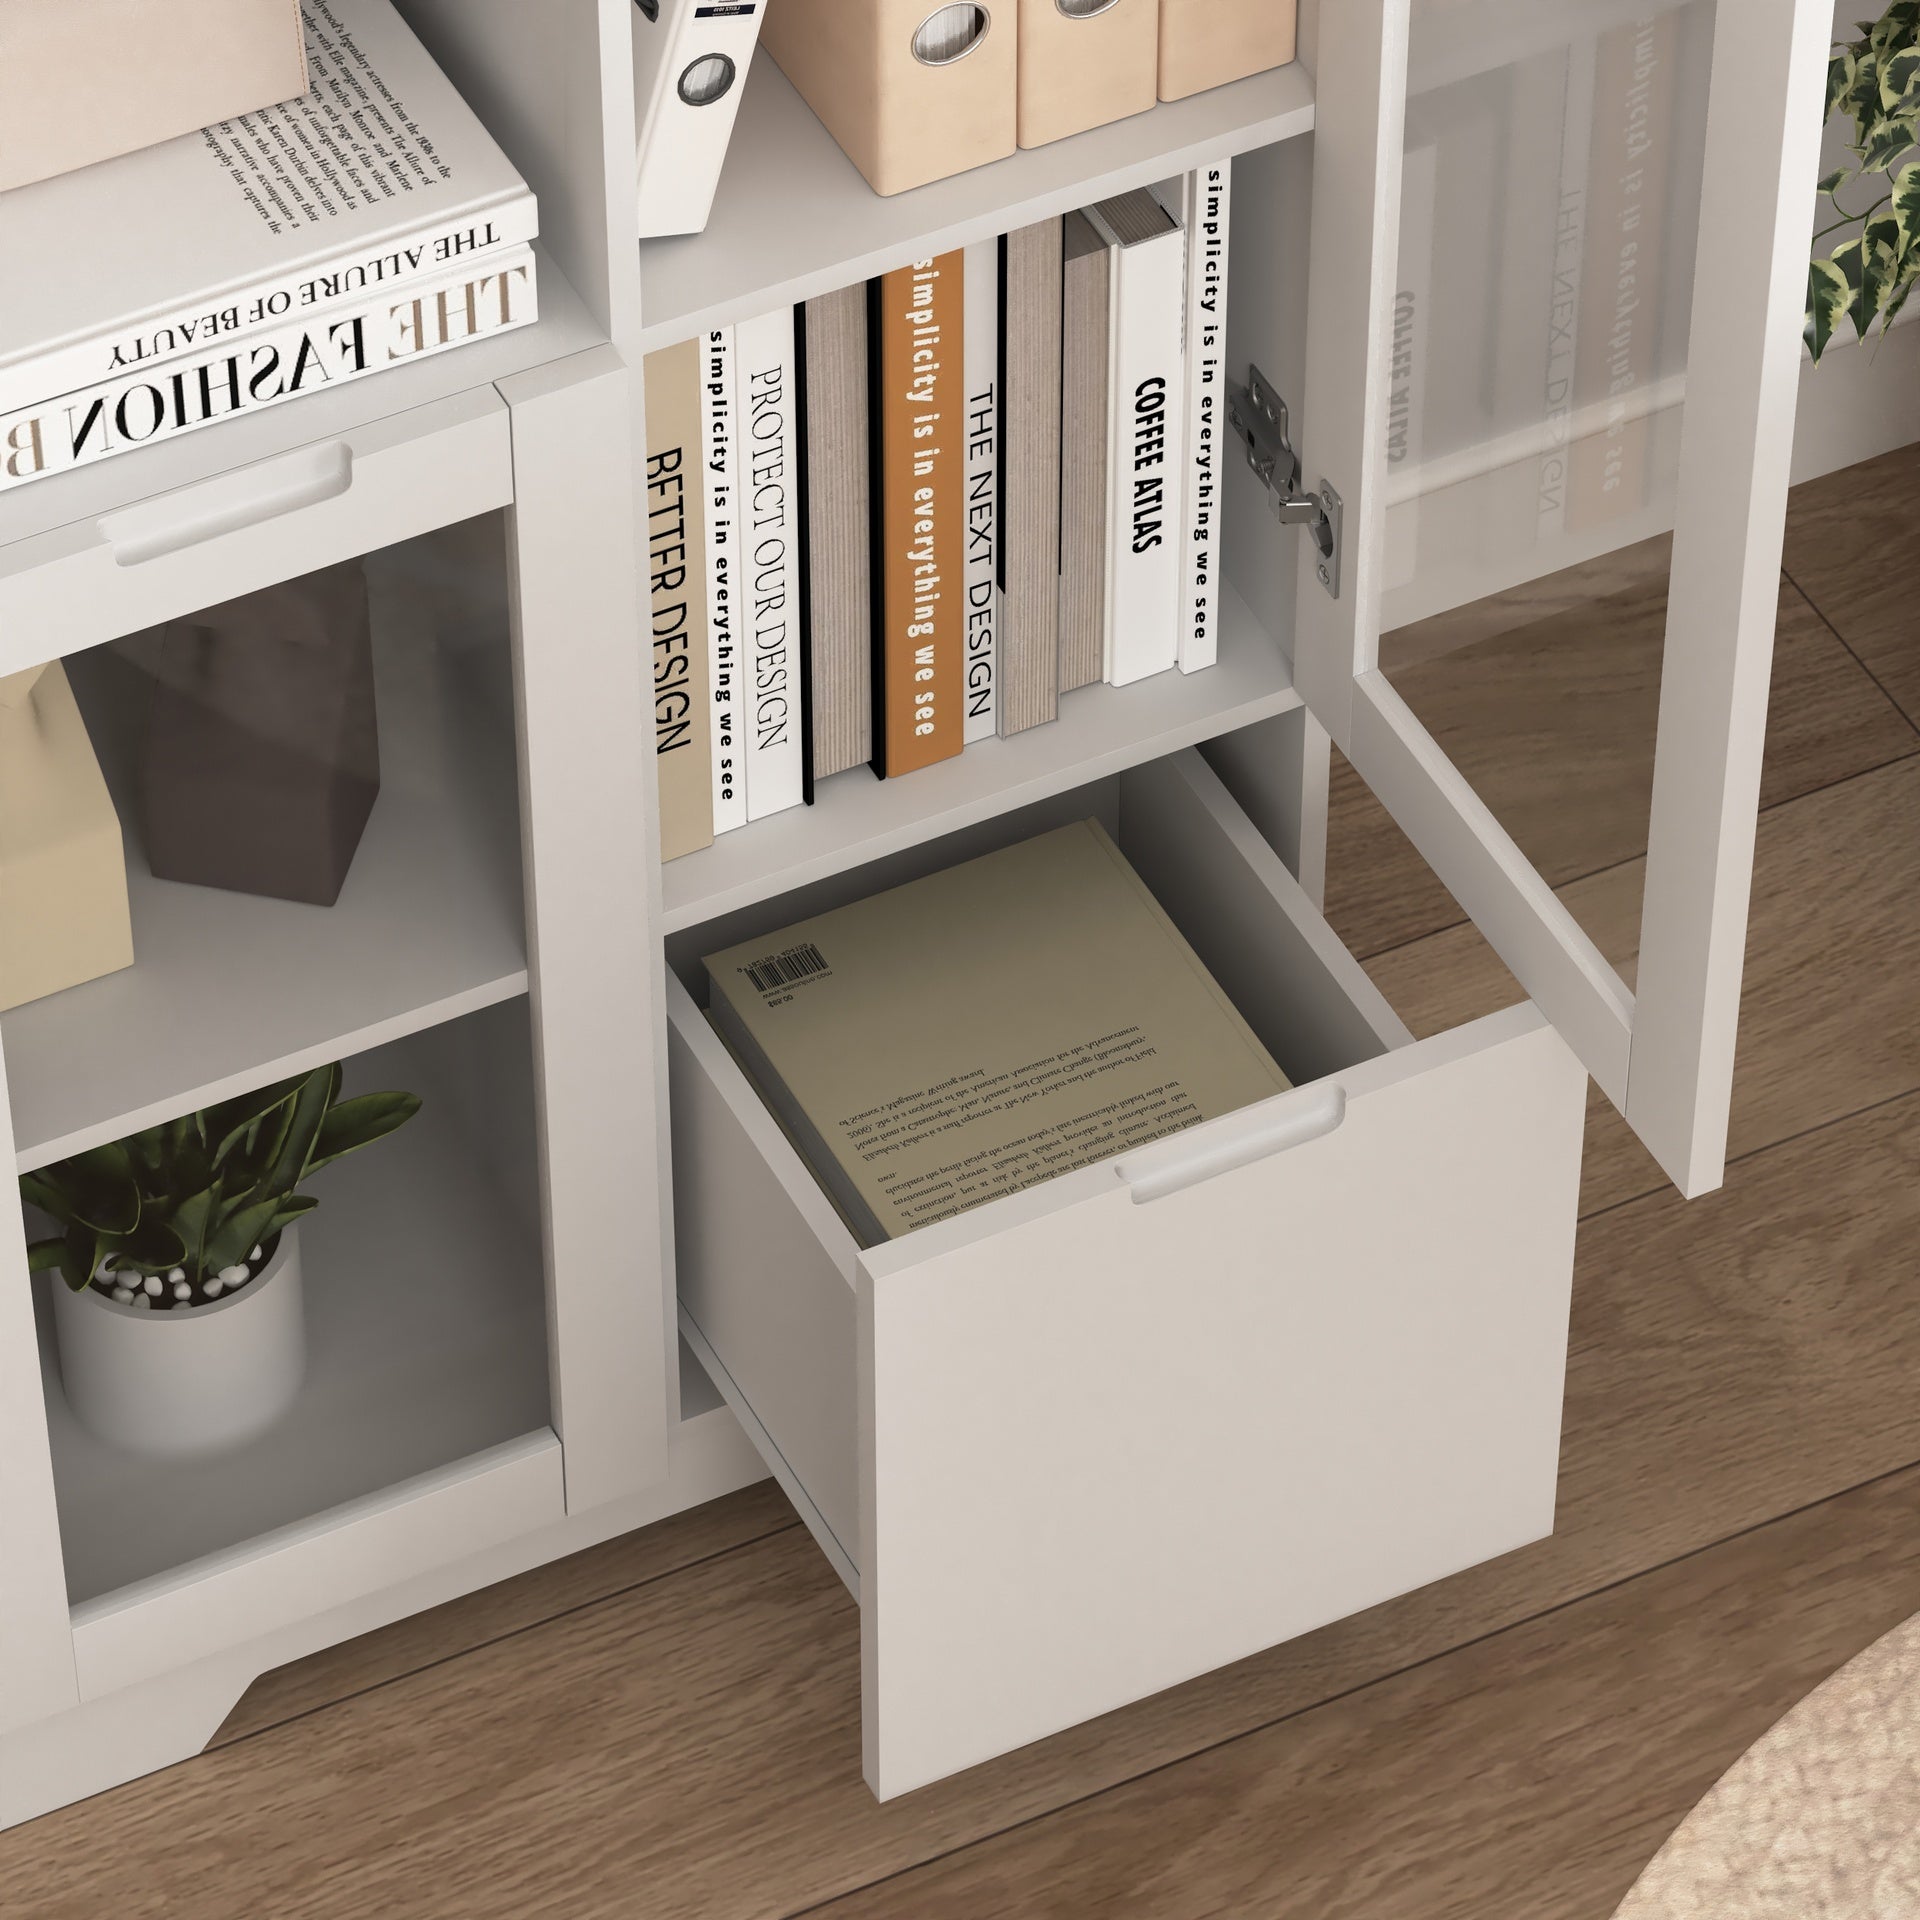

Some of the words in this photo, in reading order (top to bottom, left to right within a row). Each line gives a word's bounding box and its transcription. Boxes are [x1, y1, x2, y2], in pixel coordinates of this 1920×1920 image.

[283, 114, 299, 123] of
[307, 55, 328, 77] From
[325, 77, 352, 108] Marilyn
[372, 142, 392, 158] and
[385, 159, 413, 190] Marlene
[316, 32, 334, 50] with
[328, 50, 345, 65] Elle
[362, 103, 394, 134] presents
[390, 134, 406, 149] The
[401, 151, 424, 175] Allure
[421, 176, 437, 185] of
[321, 104, 342, 122] each
[331, 123, 353, 140] page
[338, 32, 371, 69] legendary
[389, 101, 408, 122] from
[404, 121, 419, 135] the
[436, 165, 450, 178] the
[290, 122, 314, 150] women
[300, 107, 316, 116] of
[345, 167, 365, 187] faces
[359, 188, 380, 204] and
[309, 149, 320, 160] in
[350, 142, 366, 152] of
[357, 152, 374, 168] this
[254, 137, 270, 154] who
[266, 154, 284, 173] have
[275, 174, 304, 202] proven
[300, 202, 319, 221] their
[255, 173, 295, 220] accompanies
[266, 123, 288, 148] Karen
[303, 175, 326, 199] delves
[320, 198, 337, 216] into
[315, 157, 355, 201] Hollywood
[370, 169, 395, 197] vibrant
[229, 168, 247, 185] that
[242, 187, 270, 219] captures
[267, 220, 281, 234] the
[346, 200, 357, 210] as
[434, 223, 501, 262] THE
[1200, 170, 1223, 312] simplicity
[300, 245, 424, 306] ALLURE
[249, 290, 293, 324] OF
[905, 257, 940, 402] simplicity
[108, 306, 240, 370] BEAUTY
[1203, 325, 1219, 347] is
[1202, 359, 1218, 383] in
[707, 331, 729, 473] simplicity
[913, 413, 940, 439] is
[969, 382, 993, 461] THE
[1134, 377, 1166, 472] COFFEE
[750, 364, 785, 531] PROTECT
[914, 448, 940, 476] in
[1193, 396, 1216, 542] everything
[646, 446, 686, 594] BETTER
[714, 486, 730, 508] is
[969, 469, 993, 566] NEXT
[1132, 477, 1163, 554] ATLAS
[715, 520, 731, 544] in
[754, 538, 786, 621] OUR
[907, 487, 941, 638] everything
[1196, 550, 1210, 587] we
[713, 557, 734, 703] everything
[1194, 597, 1207, 639] see
[915, 644, 934, 682] we
[968, 580, 992, 718] DESIGN
[652, 601, 692, 755] DESIGN
[755, 618, 788, 751] DESIGN
[719, 712, 732, 747] we
[915, 692, 935, 736] see
[721, 758, 733, 800] see
